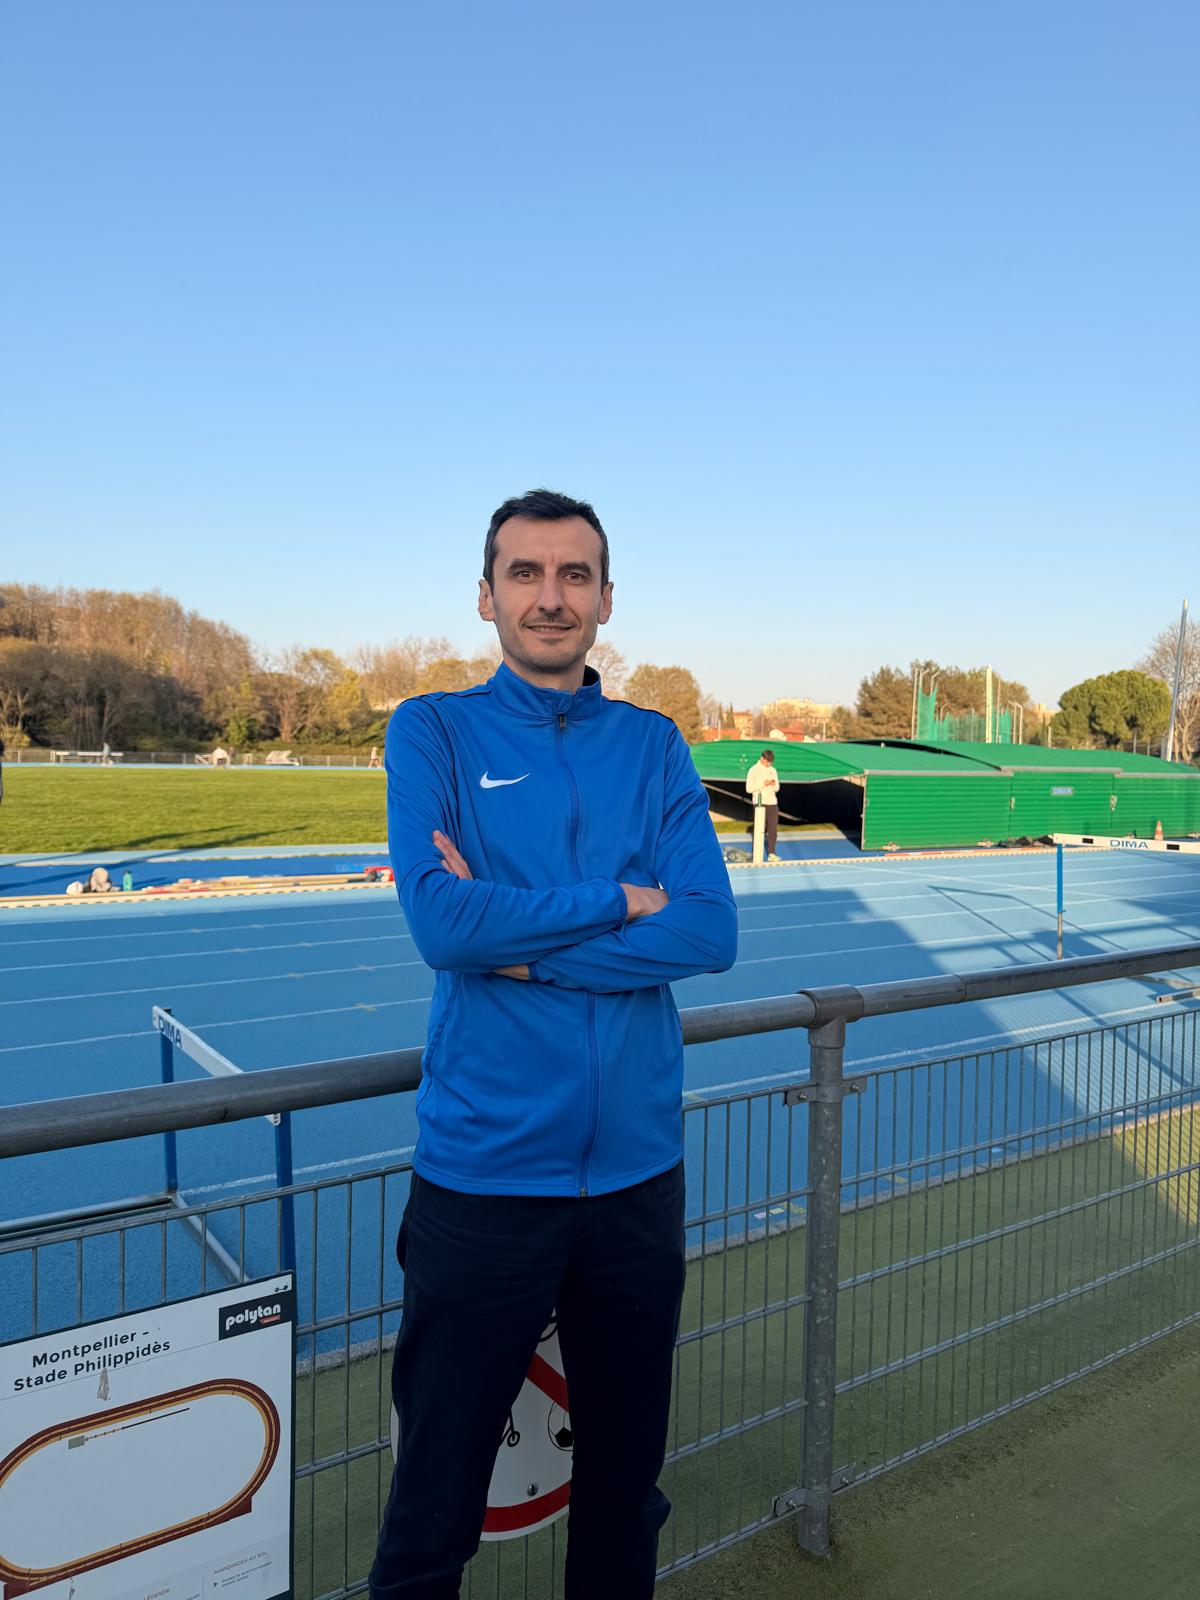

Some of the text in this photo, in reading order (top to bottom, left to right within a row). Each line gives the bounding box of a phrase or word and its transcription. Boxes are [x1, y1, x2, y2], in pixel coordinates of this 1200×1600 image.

[1109, 839, 1148, 849] DIMA
[158, 1015, 183, 1049] DIMA
[225, 1303, 281, 1331] polytan
[14, 1341, 171, 1391] Stade Philippidès
[32, 1331, 137, 1368] Montpellier
